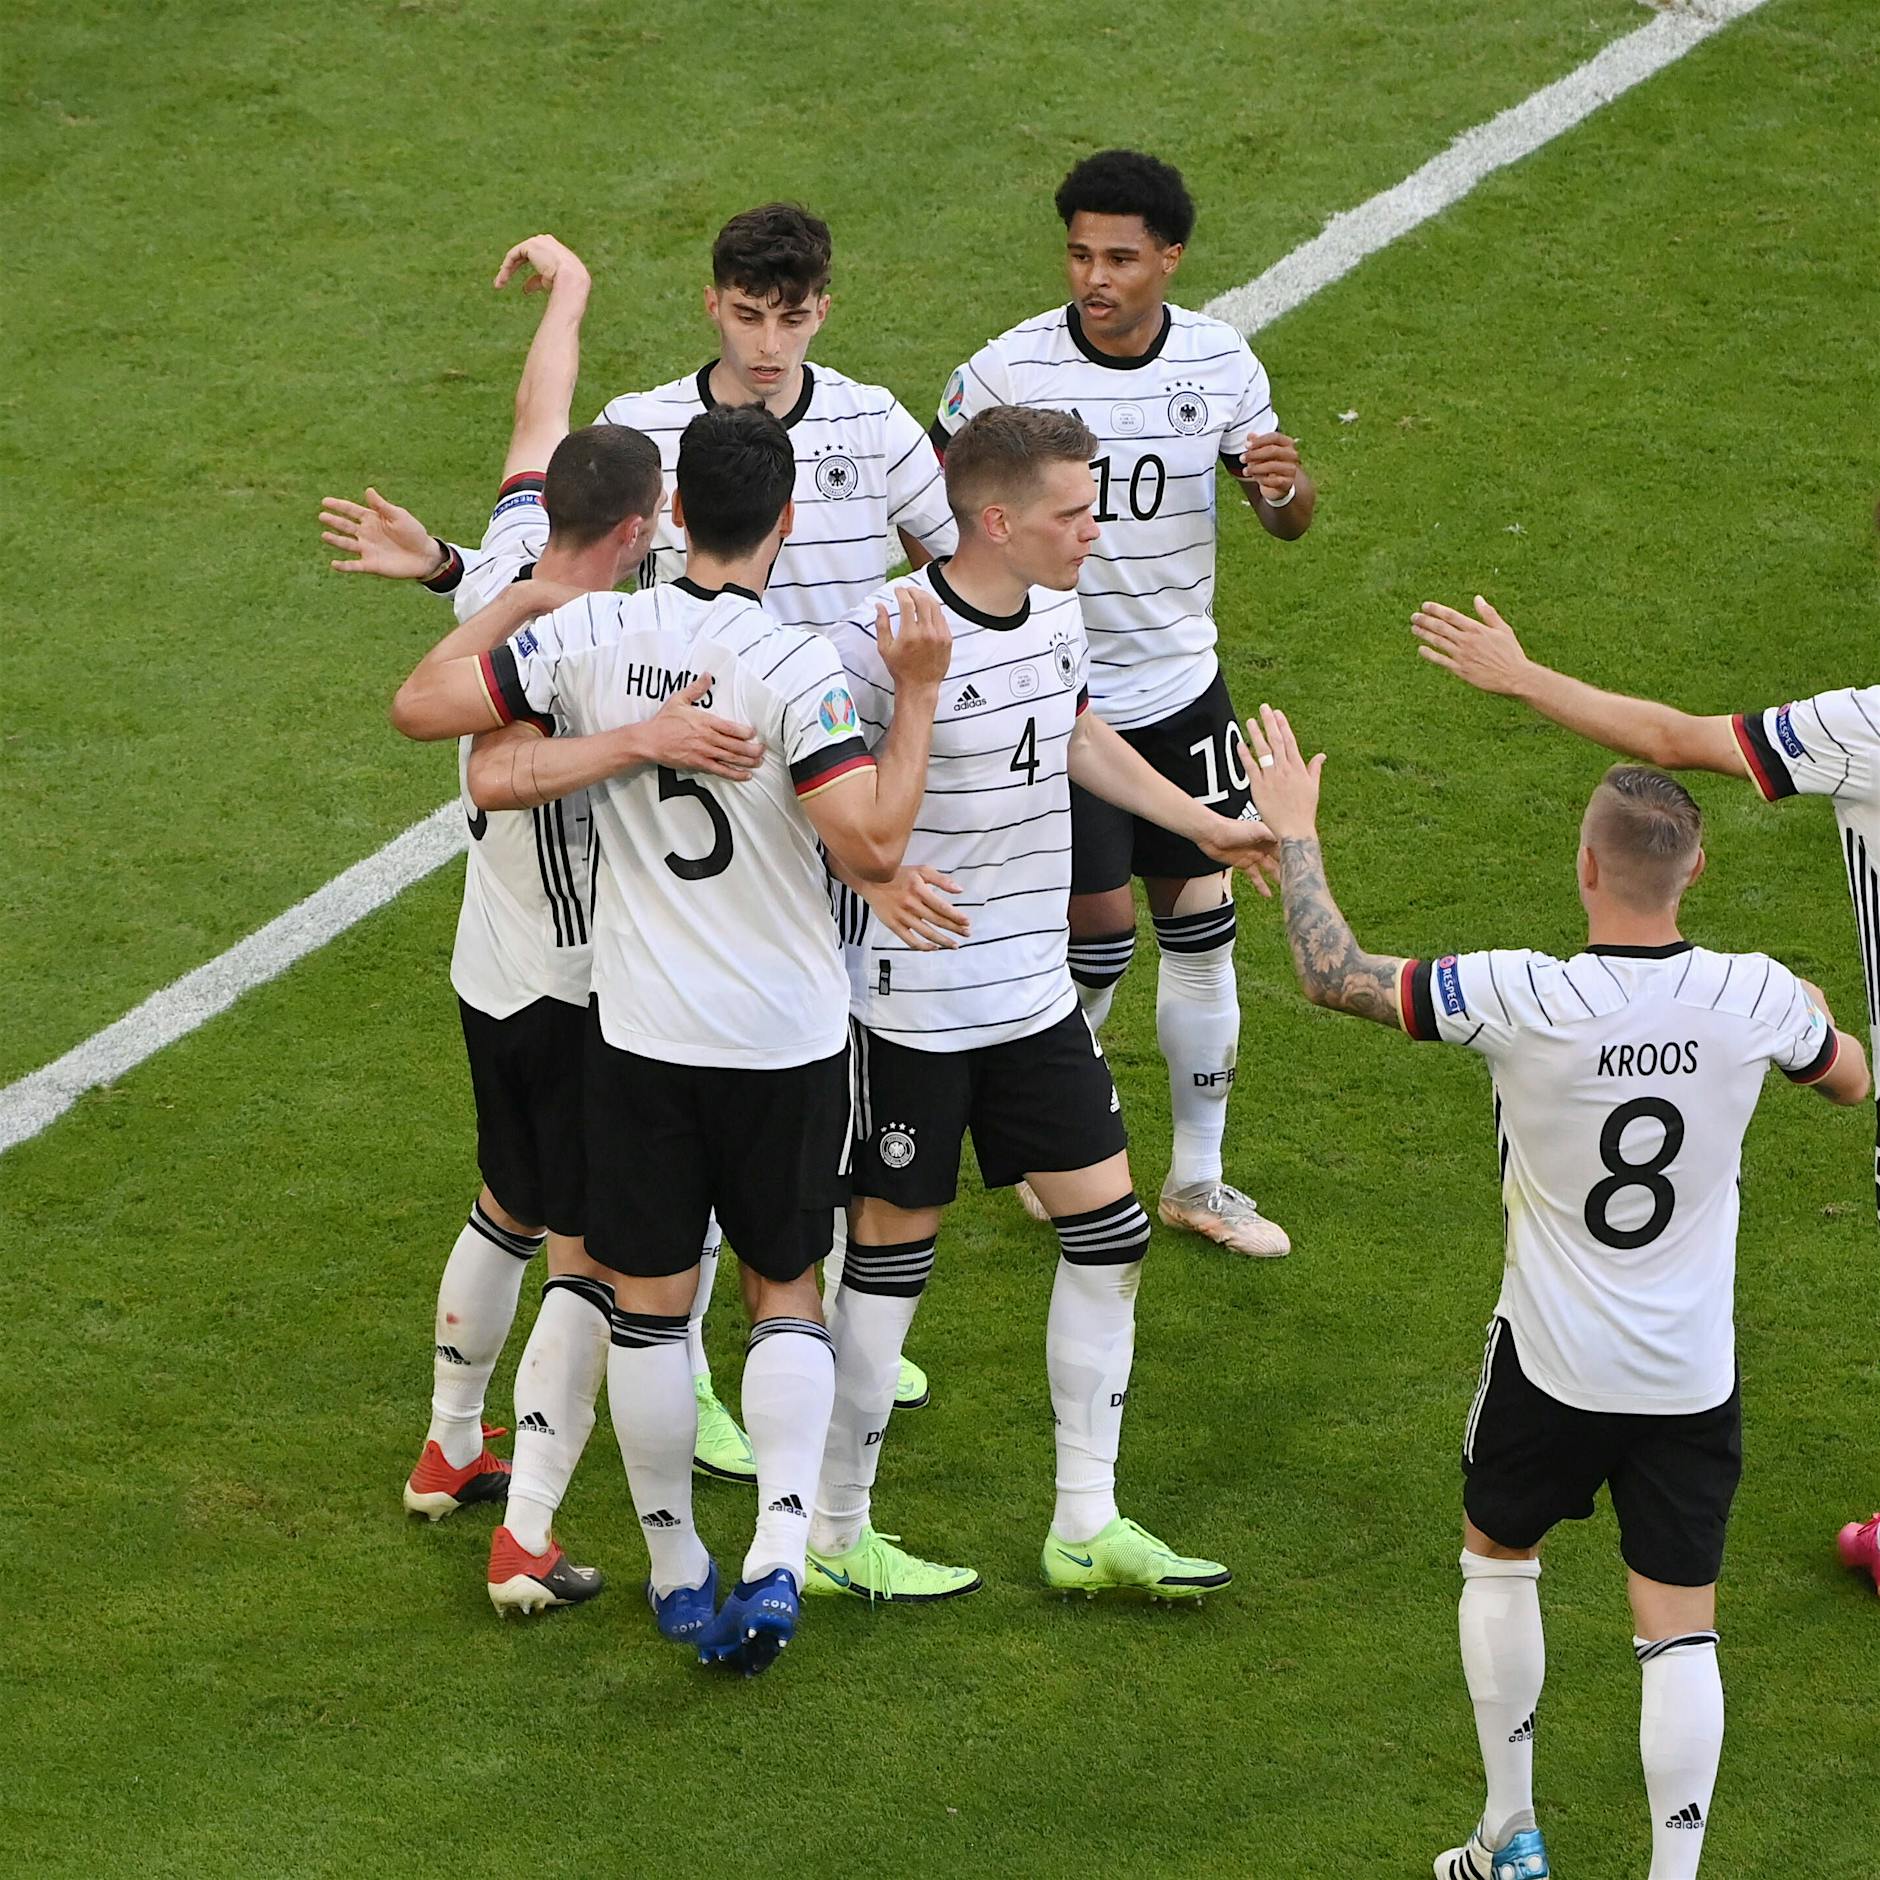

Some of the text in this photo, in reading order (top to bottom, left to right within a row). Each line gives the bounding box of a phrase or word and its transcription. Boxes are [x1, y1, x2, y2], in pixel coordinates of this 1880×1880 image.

[1088, 454, 1166, 523] 10
[953, 698, 987, 711] adidas
[1010, 717, 1040, 786] 4
[1778, 715, 1801, 757] RESPECT
[658, 767, 733, 880] 5
[1442, 967, 1461, 1013] RESPECT
[1193, 1067, 1237, 1087] DFB
[1597, 1040, 1699, 1077] KROOS
[1584, 1096, 1685, 1250] 8
[768, 1503, 808, 1519] adidas
[762, 1599, 793, 1613] COPA
[671, 1619, 704, 1634] COPA
[1665, 1820, 1705, 1830] adidas
